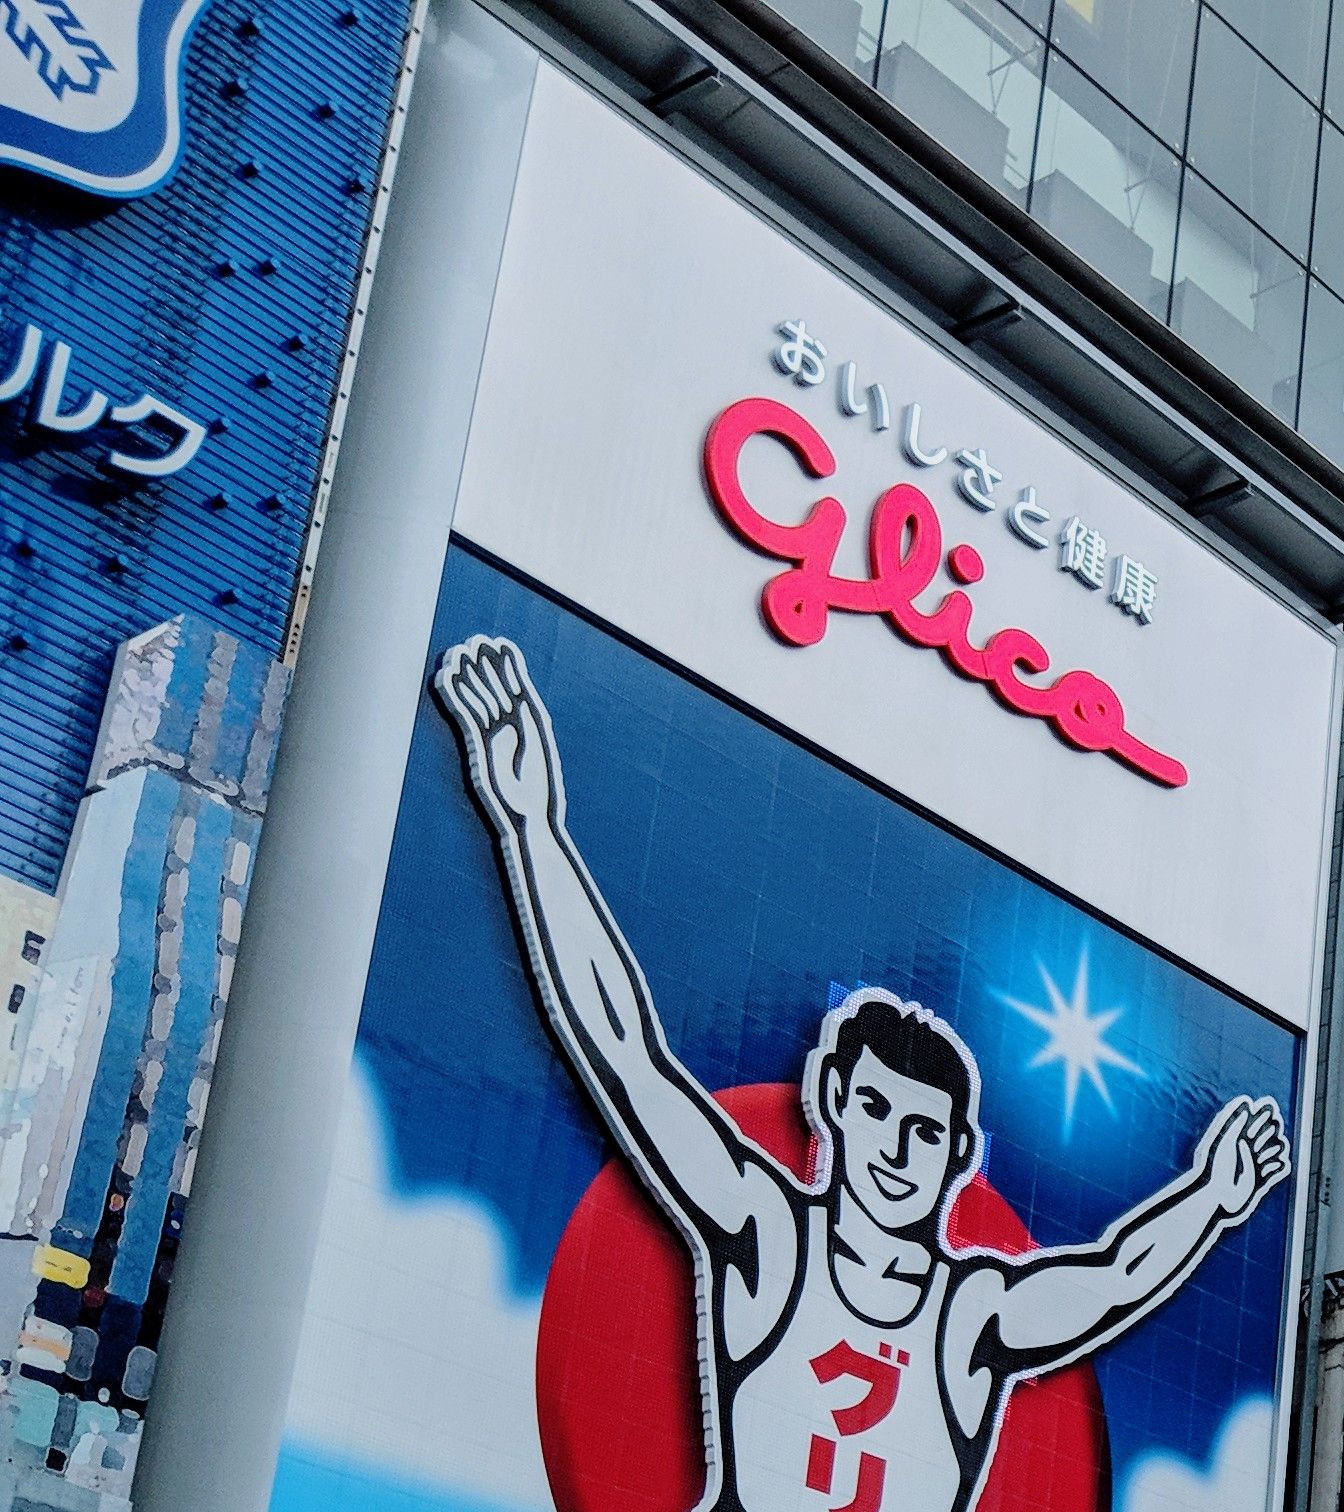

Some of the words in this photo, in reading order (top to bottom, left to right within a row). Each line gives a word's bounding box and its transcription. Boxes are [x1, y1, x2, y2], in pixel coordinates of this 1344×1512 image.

[703, 396, 1189, 788] Glico
[772, 318, 1158, 626] おいしさと健康
